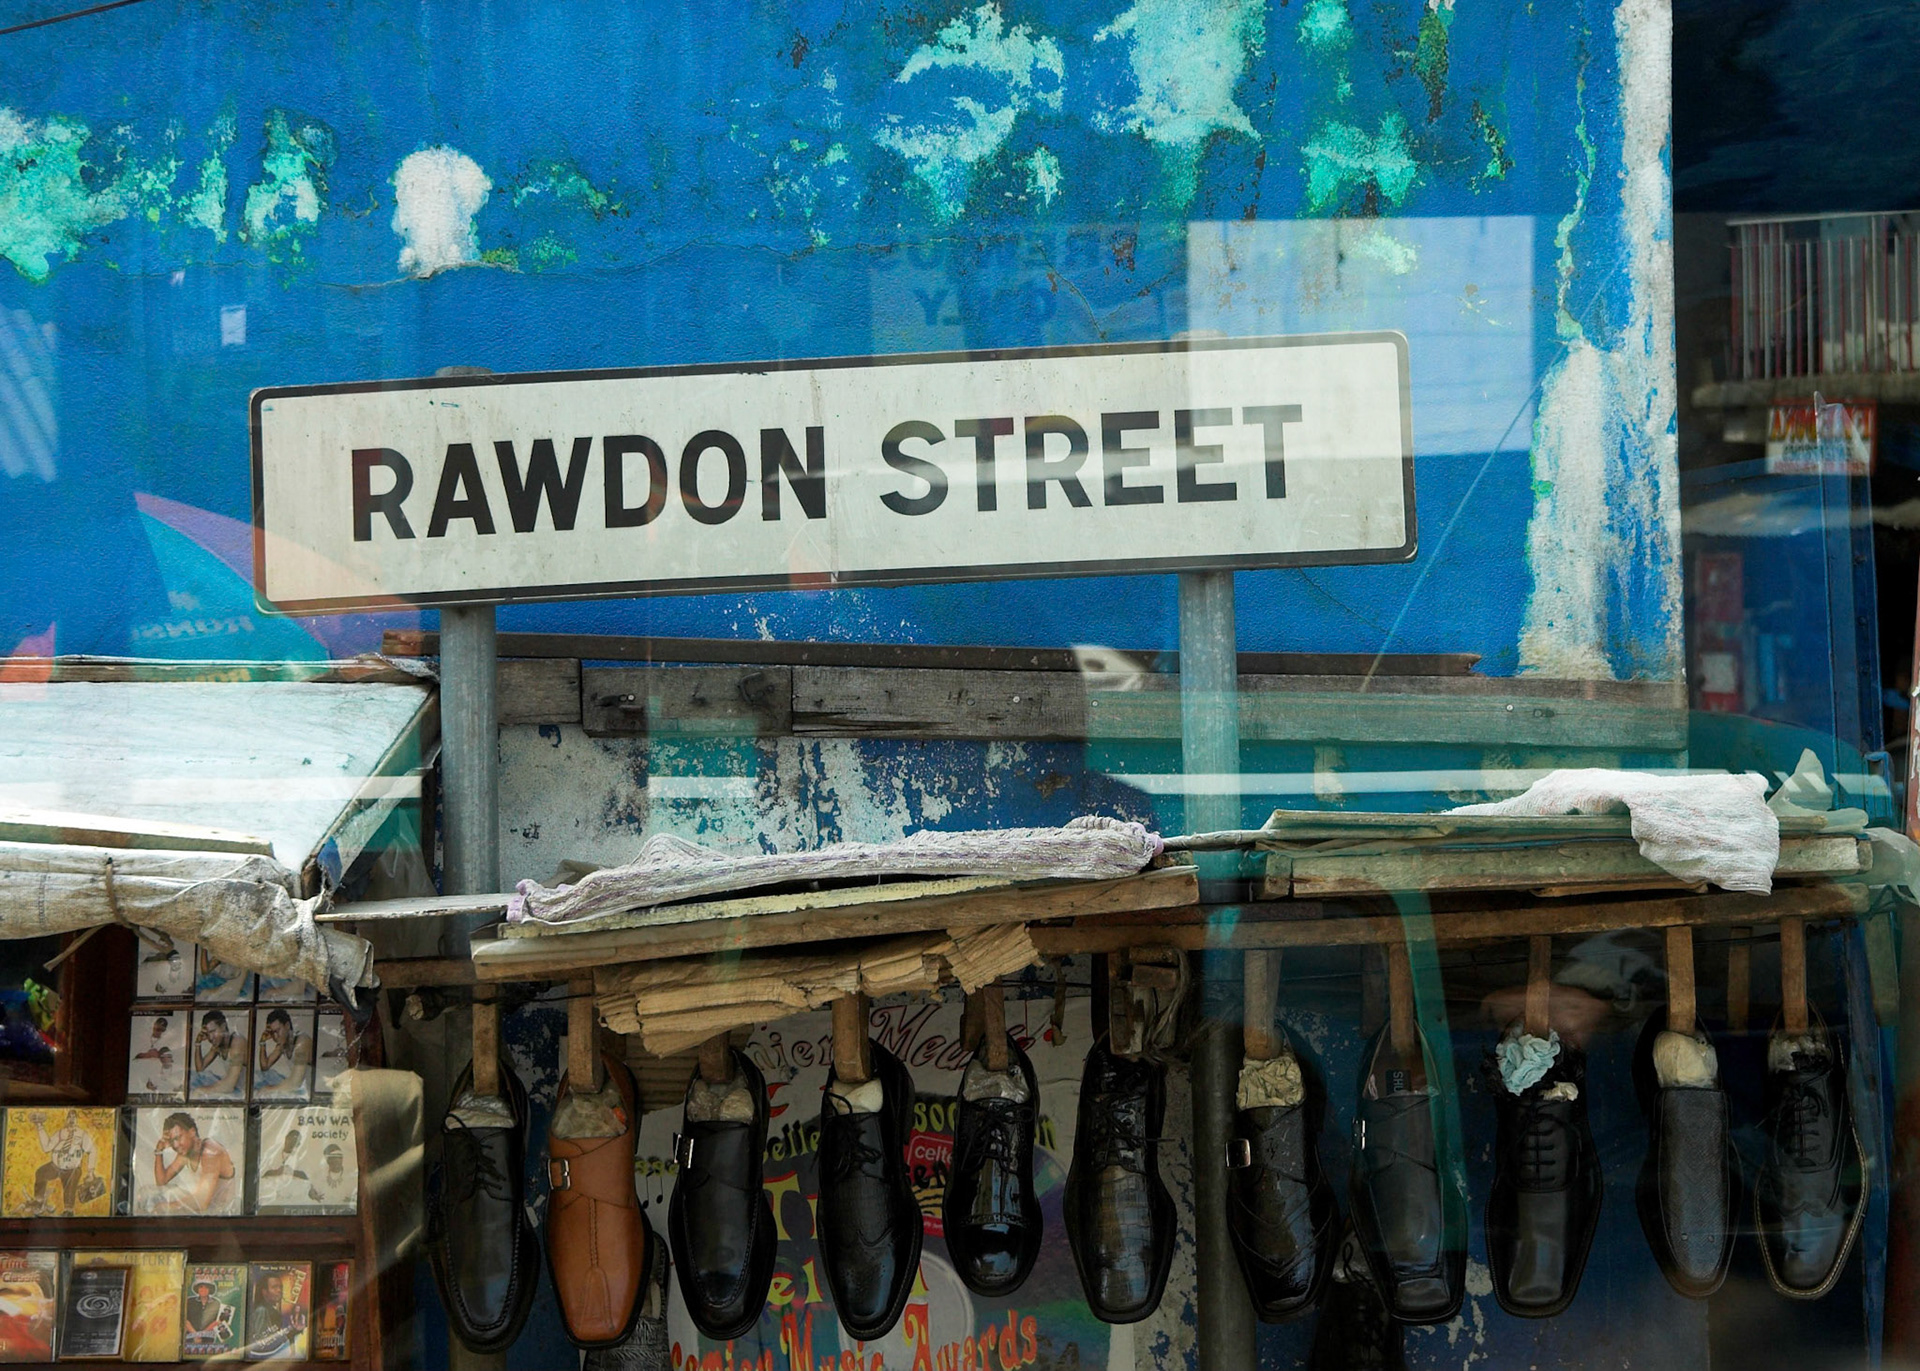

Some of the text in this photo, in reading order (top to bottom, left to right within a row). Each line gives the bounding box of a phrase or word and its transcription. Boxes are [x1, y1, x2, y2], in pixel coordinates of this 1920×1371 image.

[350, 404, 1303, 542] RAWDON STREET
[297, 1116, 354, 1126] BAW WA
[312, 1130, 349, 1141] society
